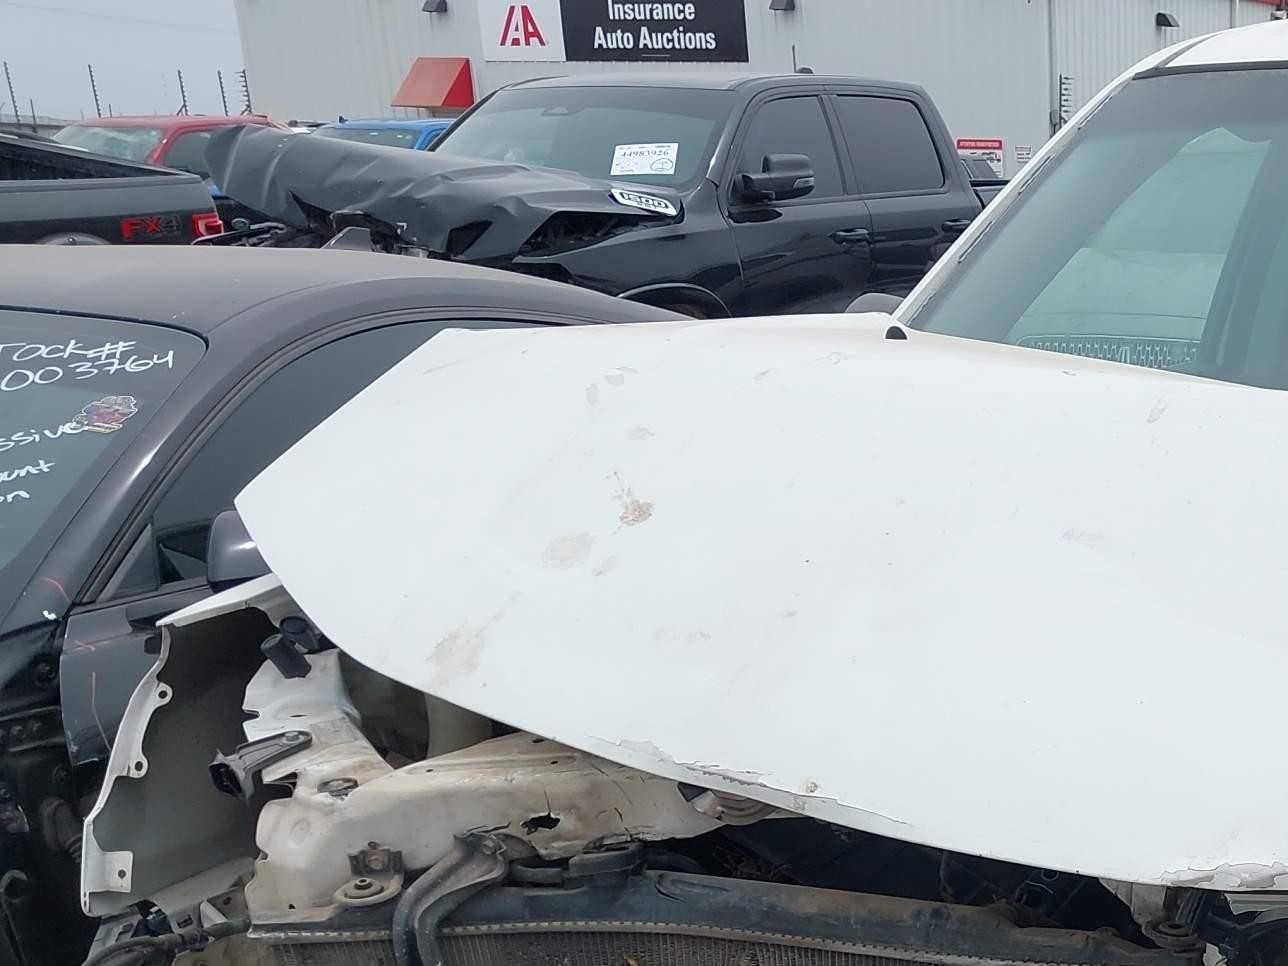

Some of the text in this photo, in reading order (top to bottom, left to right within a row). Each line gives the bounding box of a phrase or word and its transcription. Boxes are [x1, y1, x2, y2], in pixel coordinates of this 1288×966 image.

[608, 0, 696, 20] Insurance
[593, 26, 717, 50] Auto Auctions
[121, 215, 178, 240] FX4
[0, 350, 174, 391] 003764
